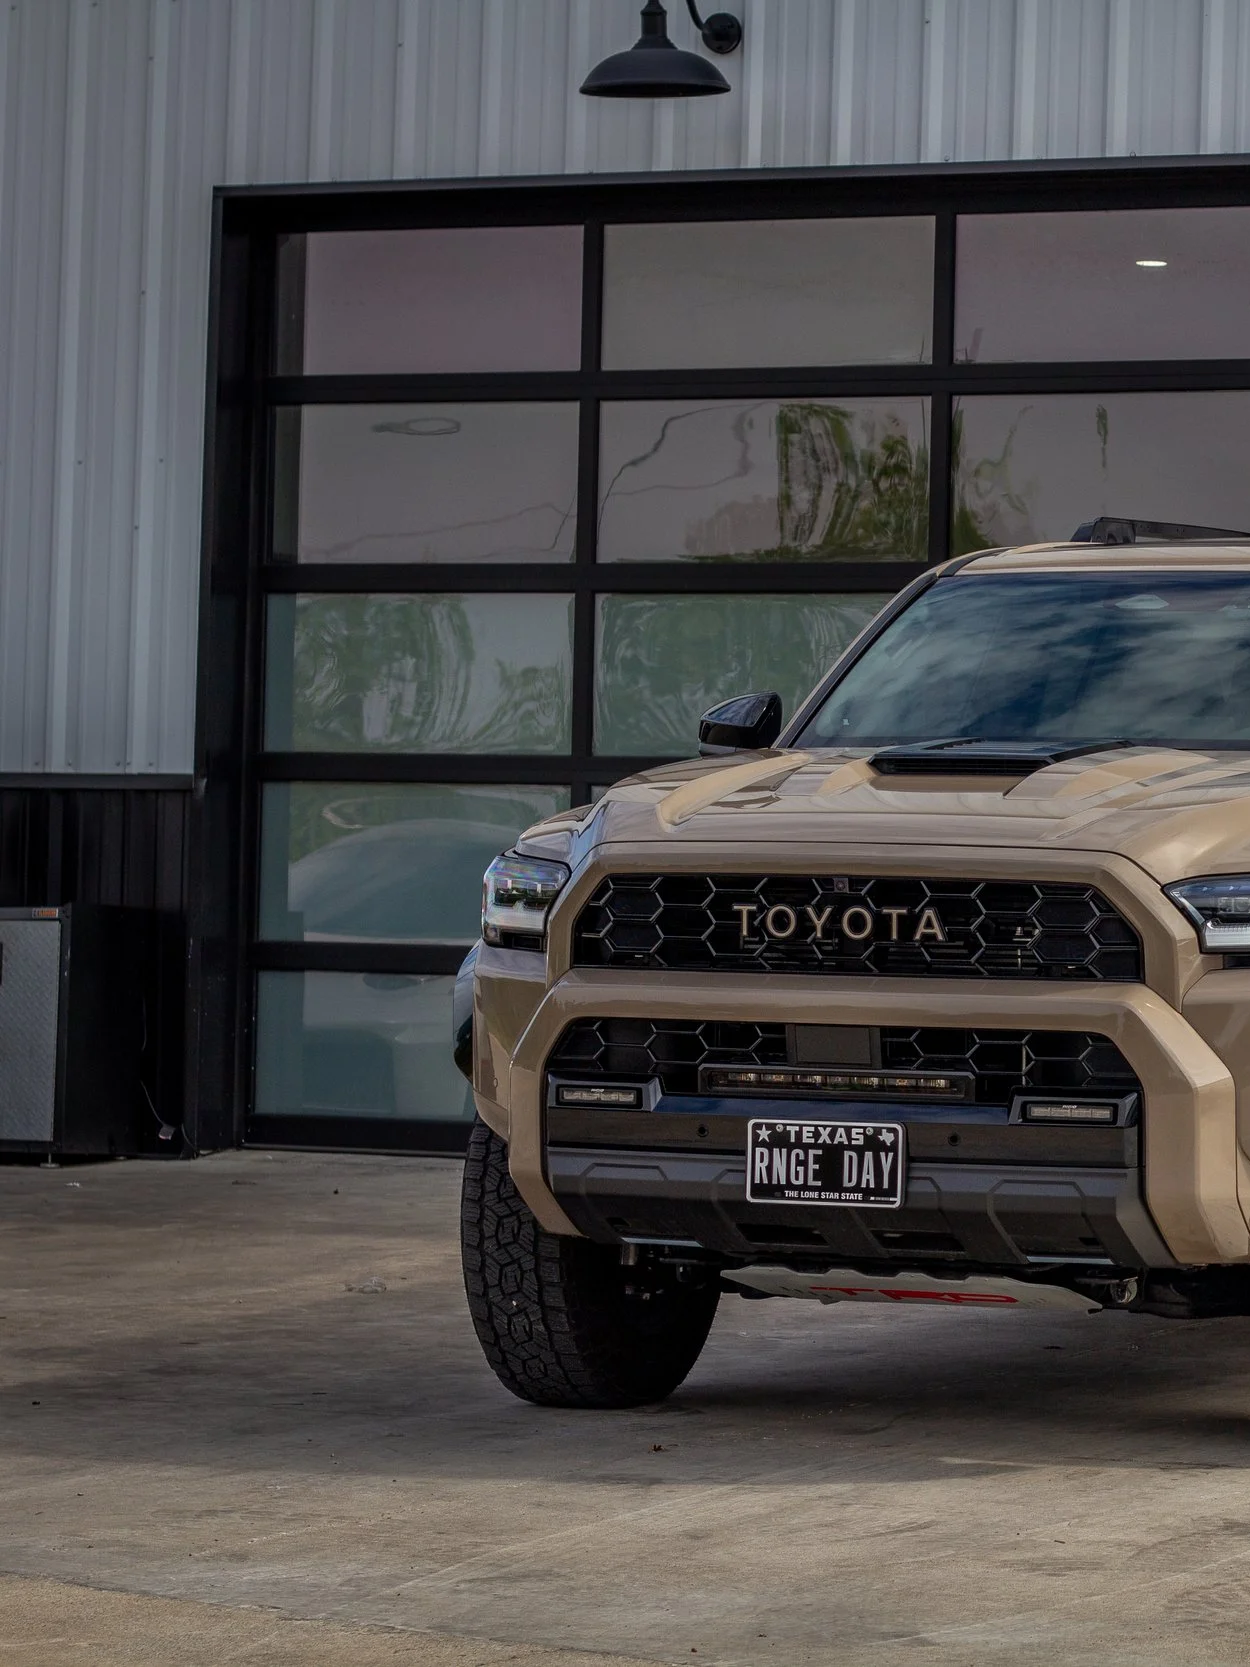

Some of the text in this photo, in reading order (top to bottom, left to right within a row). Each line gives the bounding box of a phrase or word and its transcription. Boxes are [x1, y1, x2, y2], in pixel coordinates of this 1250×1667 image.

[731, 902, 948, 942] TOYOTA
[786, 1125, 864, 1145] TEXAS
[754, 1147, 894, 1189] RNGE DAY
[784, 1190, 799, 1198] THE
[800, 1191, 820, 1199] LONE
[820, 1192, 840, 1200] STAR
[840, 1192, 863, 1201] STATE
